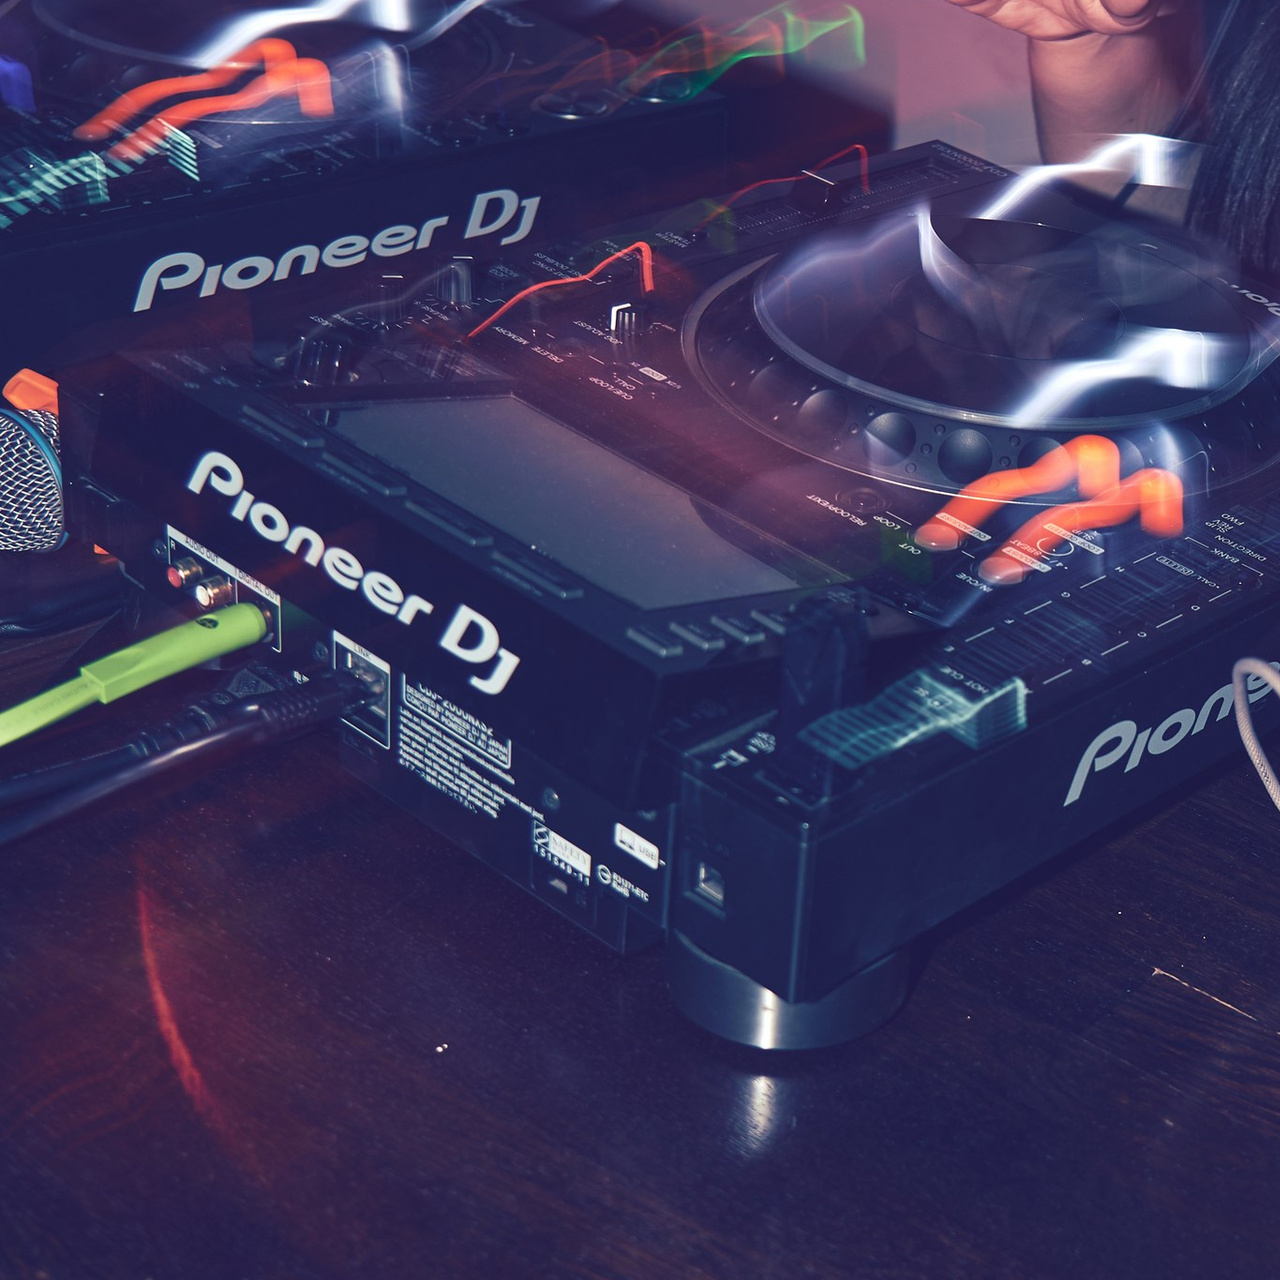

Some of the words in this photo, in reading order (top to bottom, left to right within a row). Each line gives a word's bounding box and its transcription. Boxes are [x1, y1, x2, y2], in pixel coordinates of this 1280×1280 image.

[133, 216, 449, 312] Pioneer
[464, 189, 541, 246] DJ
[491, 326, 530, 345] MEMORY
[532, 346, 564, 364] DELETE
[589, 377, 634, 401] CUE/LOOP
[806, 494, 867, 527] RELOOP/EXIT
[873, 515, 901, 530] LOOP
[1221, 513, 1245, 526] FWD
[170, 540, 176, 550] R
[899, 543, 921, 555] OUT
[1215, 535, 1267, 562] DIRECTION
[1210, 548, 1240, 564] BANK
[188, 450, 433, 626] Pioneer
[438, 603, 521, 696] DJ
[956, 572, 993, 592] IN/CUE
[353, 643, 371, 660] LINK
[965, 680, 990, 694] HOT
[638, 845, 657, 860] USB
